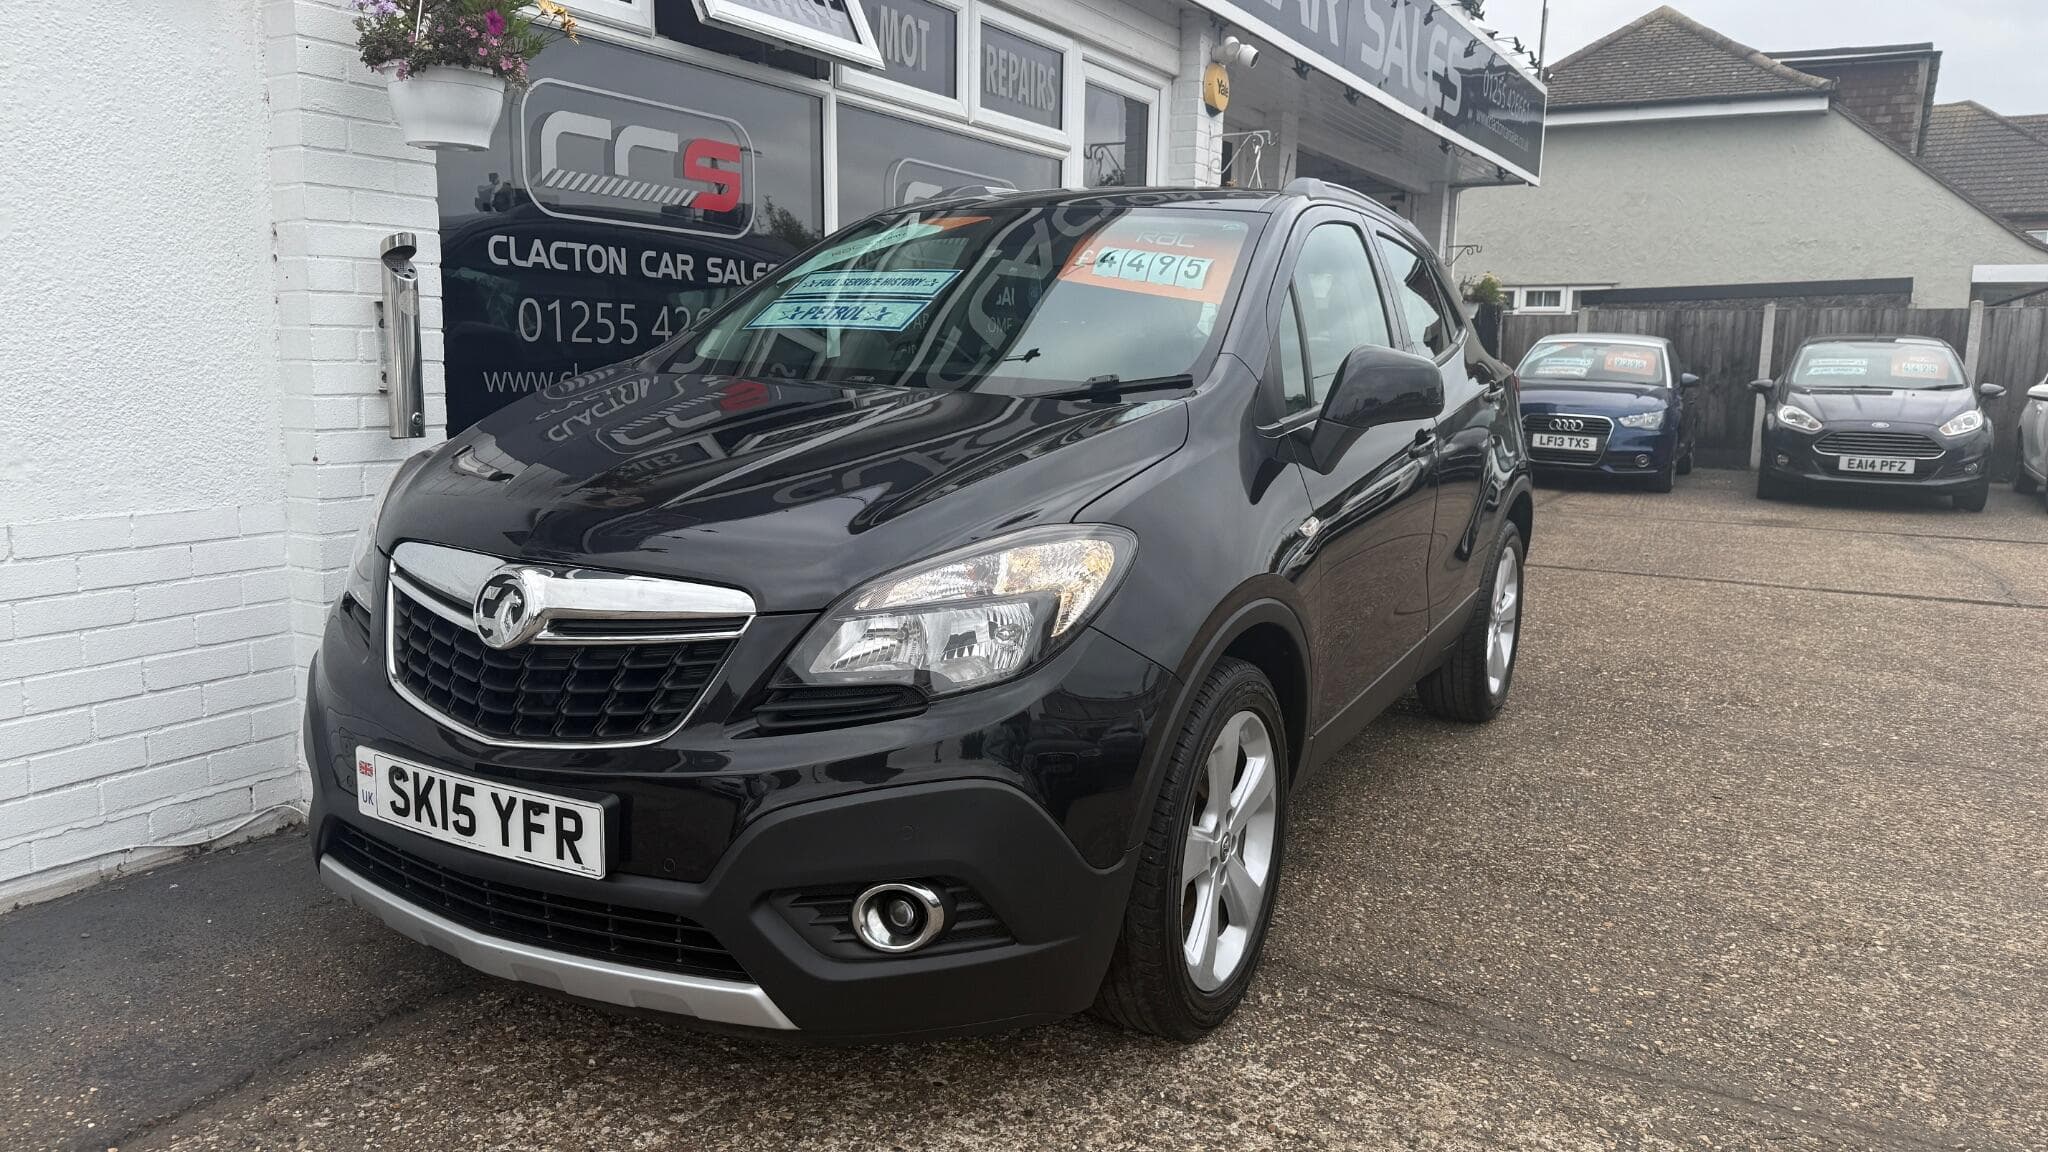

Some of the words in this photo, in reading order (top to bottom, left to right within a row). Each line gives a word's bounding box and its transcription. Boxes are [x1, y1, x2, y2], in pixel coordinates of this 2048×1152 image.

[879, 5, 929, 71] MOT
[1361, 0, 1461, 119] SALES
[986, 44, 1056, 112] REPAIRS
[1217, 78, 1229, 98] Yale
[541, 110, 741, 212] CCS
[488, 234, 626, 275] CLACTON
[641, 250, 694, 280] CAR
[814, 278, 839, 288] FULL
[841, 277, 882, 287] SERVICE
[881, 277, 923, 287] HISTORY
[518, 298, 638, 345] 01255
[800, 305, 866, 321] PETROL
[1539, 436, 1565, 448] LF13
[1568, 438, 1590, 449] TXS
[1847, 458, 1877, 470] EA14
[1880, 459, 1907, 472] PFZ
[361, 789, 375, 807] UK
[388, 764, 476, 837] SK15
[490, 791, 585, 866] YFR
